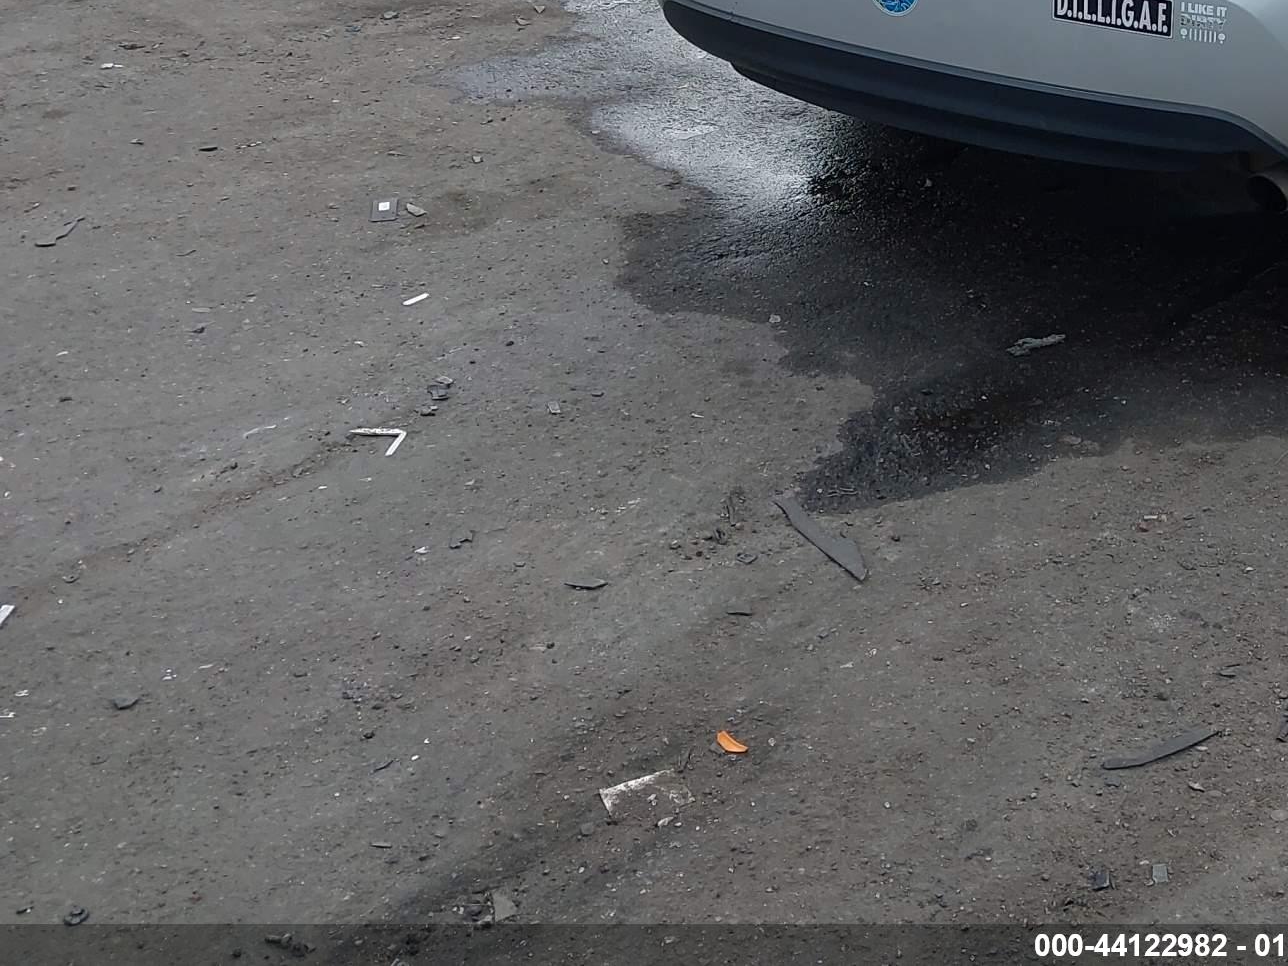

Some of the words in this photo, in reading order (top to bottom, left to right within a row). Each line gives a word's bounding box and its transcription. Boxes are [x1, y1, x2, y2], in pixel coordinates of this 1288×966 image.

[1180, 2, 1186, 11] I
[1187, 2, 1214, 16] LIKE
[1216, 6, 1228, 17] IT
